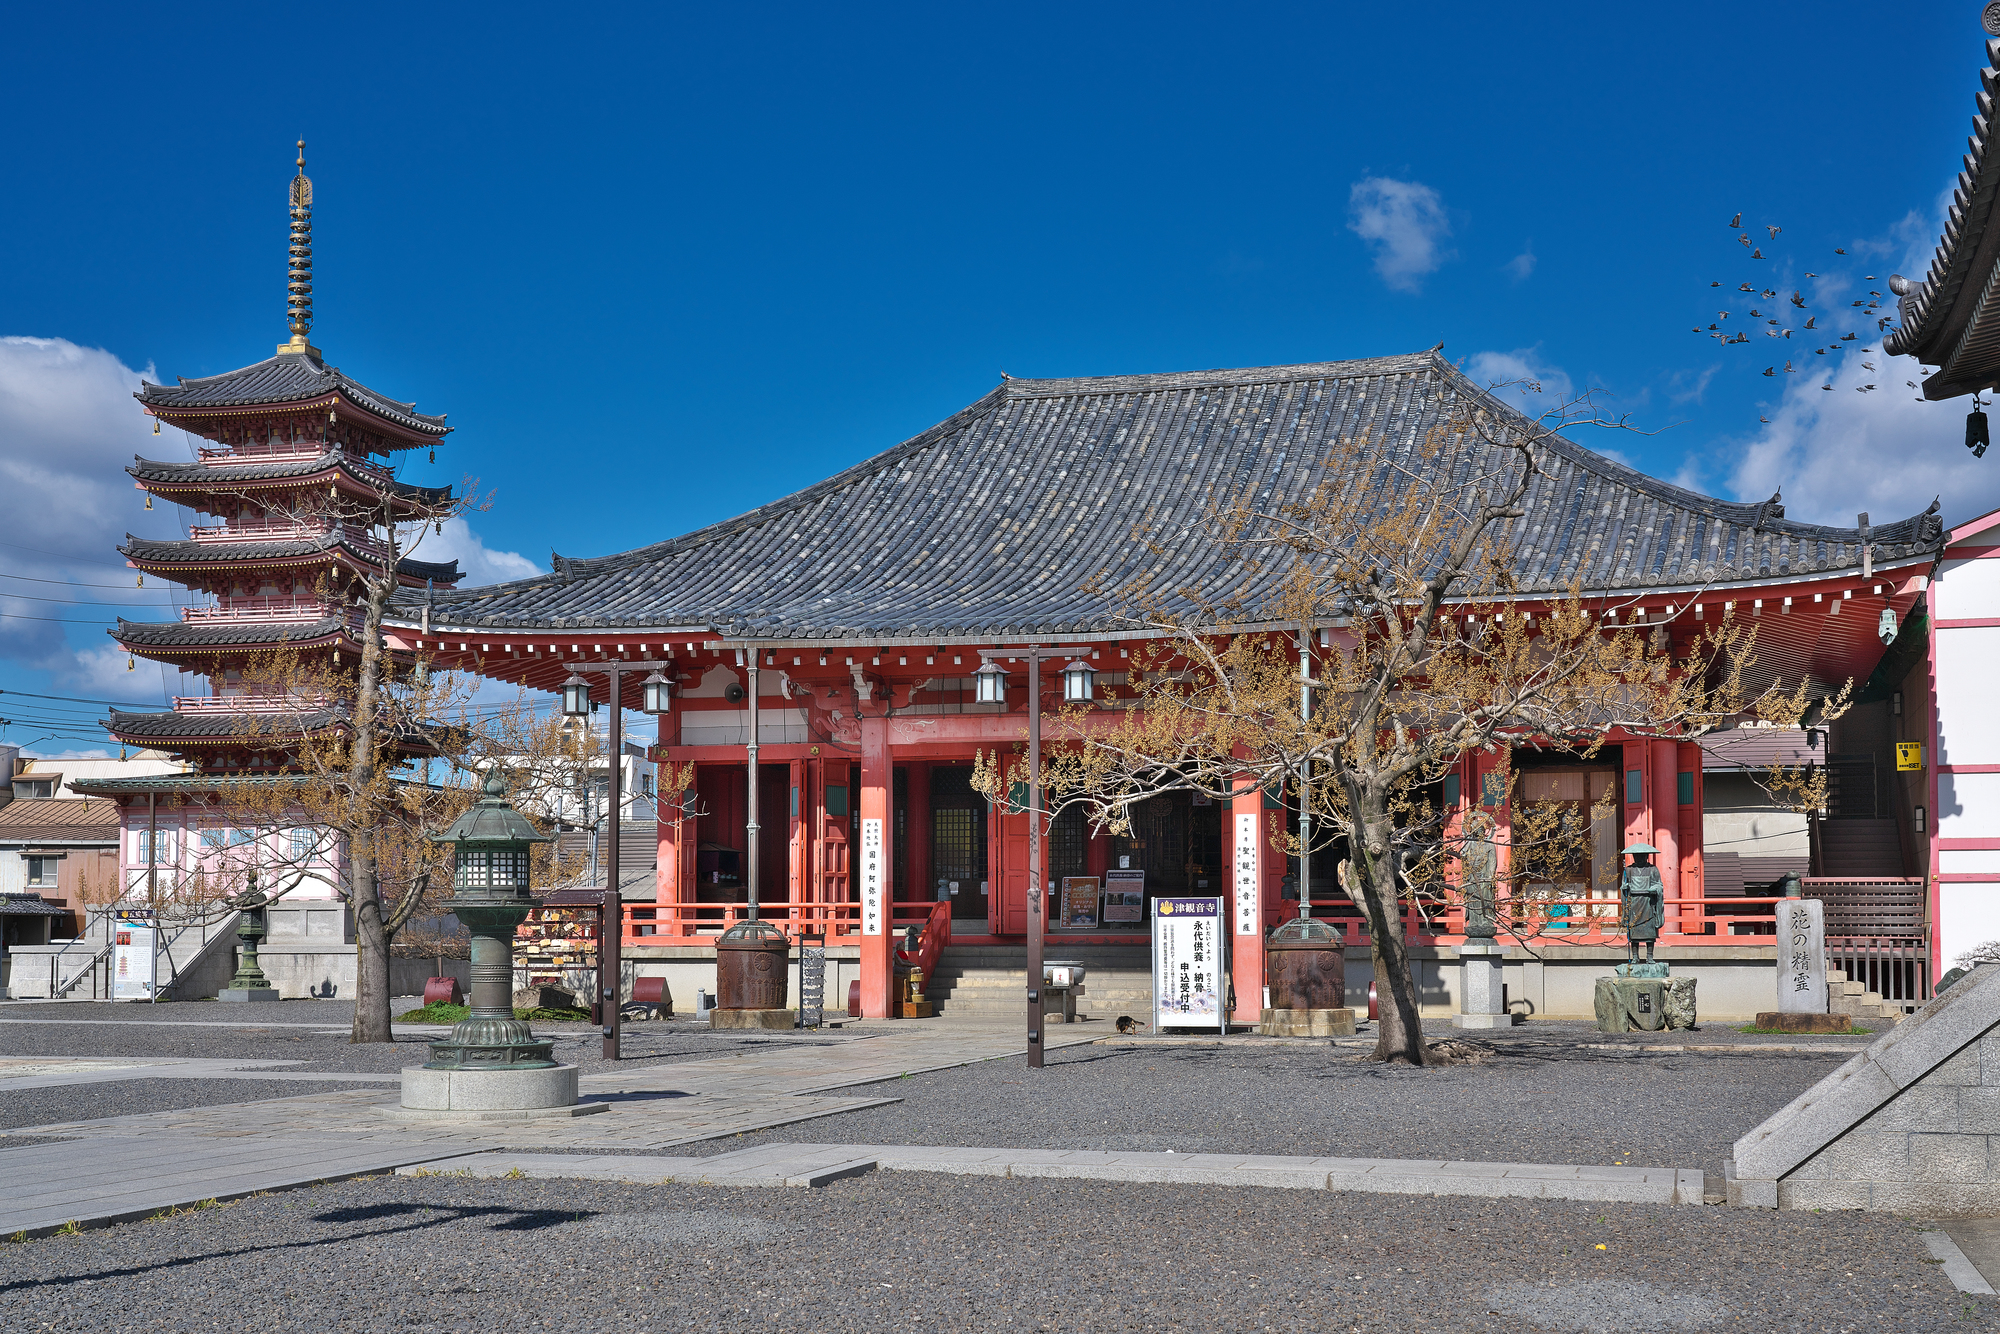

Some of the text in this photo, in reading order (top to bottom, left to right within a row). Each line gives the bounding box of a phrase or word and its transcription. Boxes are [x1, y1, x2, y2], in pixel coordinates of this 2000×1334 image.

[1175, 903, 1216, 913] 津観音寺
[1242, 847, 1250, 931] 聖観世音菩薩
[1193, 921, 1204, 993] 永代供養・納骨
[1790, 909, 1811, 993] 花の精霊
[1180, 962, 1190, 1013] 申込受付中
